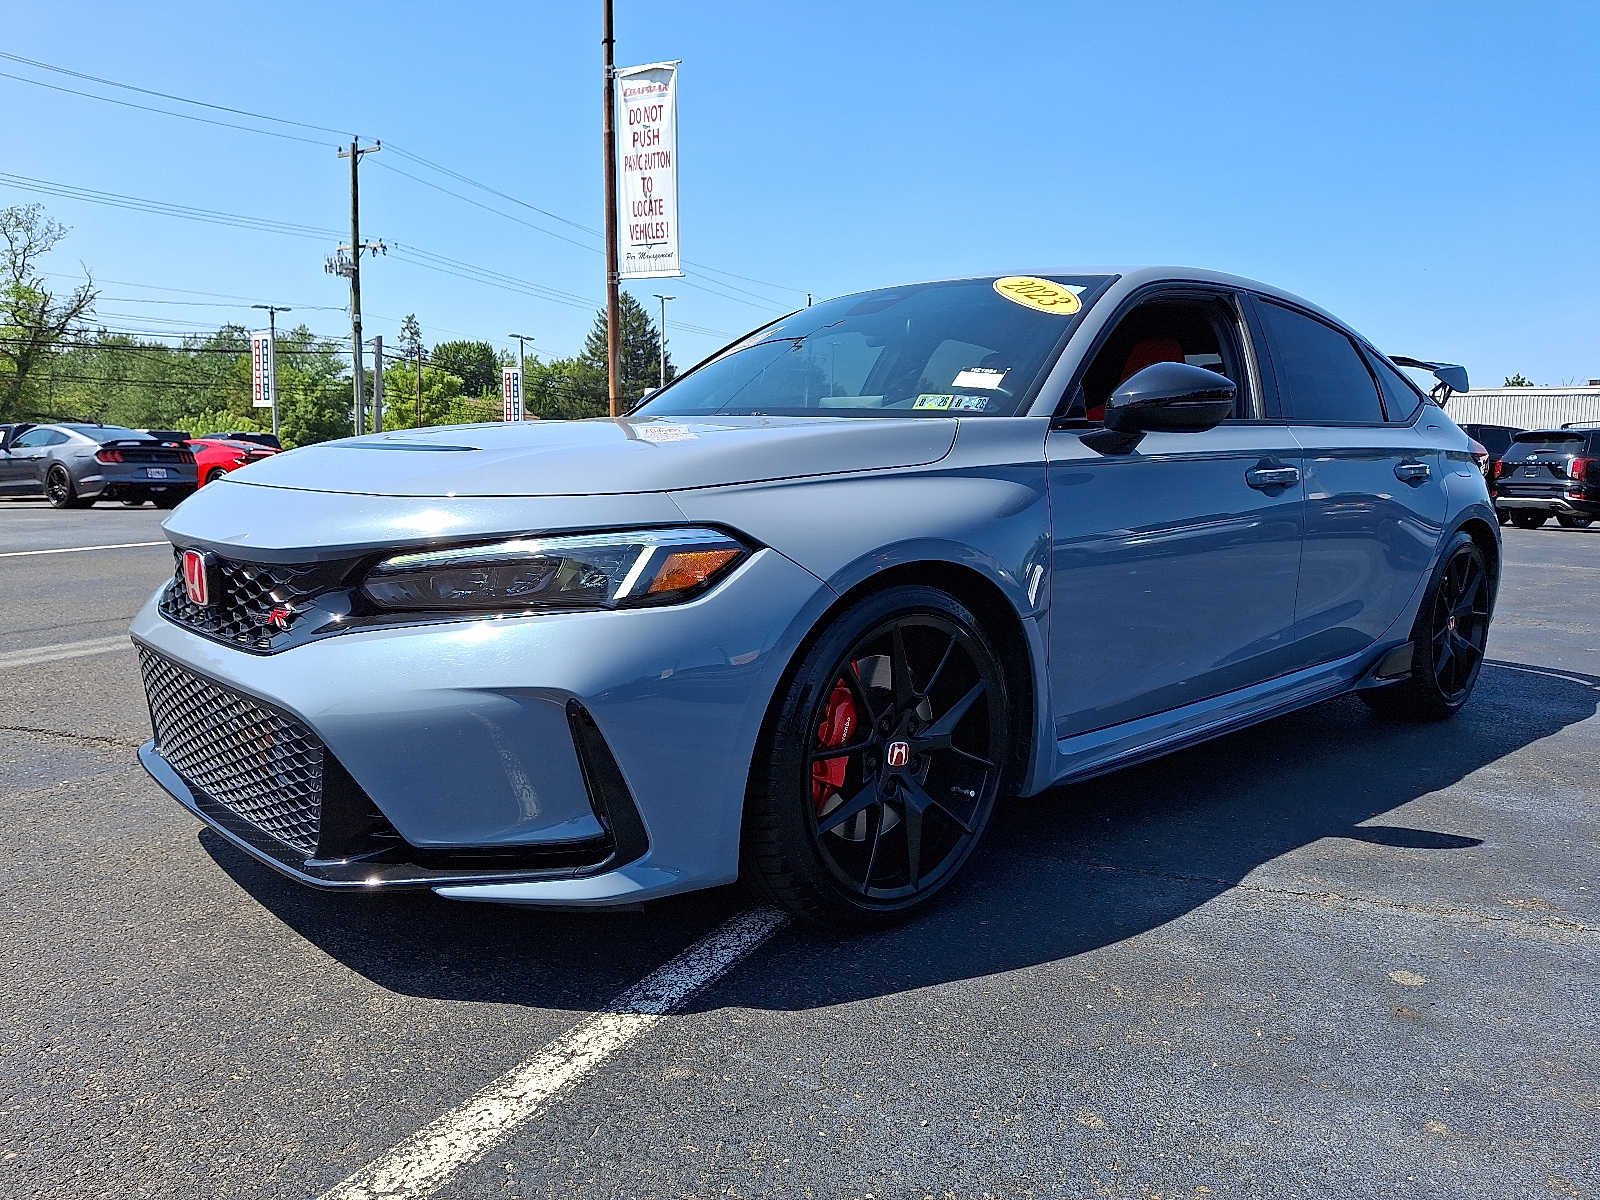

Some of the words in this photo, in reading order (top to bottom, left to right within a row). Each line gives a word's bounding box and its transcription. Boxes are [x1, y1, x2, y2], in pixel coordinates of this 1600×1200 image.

[629, 107, 642, 126] DO
[643, 104, 664, 122] NOT
[632, 128, 660, 148] PUSH
[644, 150, 671, 170] BUTTON
[641, 176, 653, 193] TO
[632, 198, 664, 217] LOCATE
[1001, 281, 1072, 306] 2023
